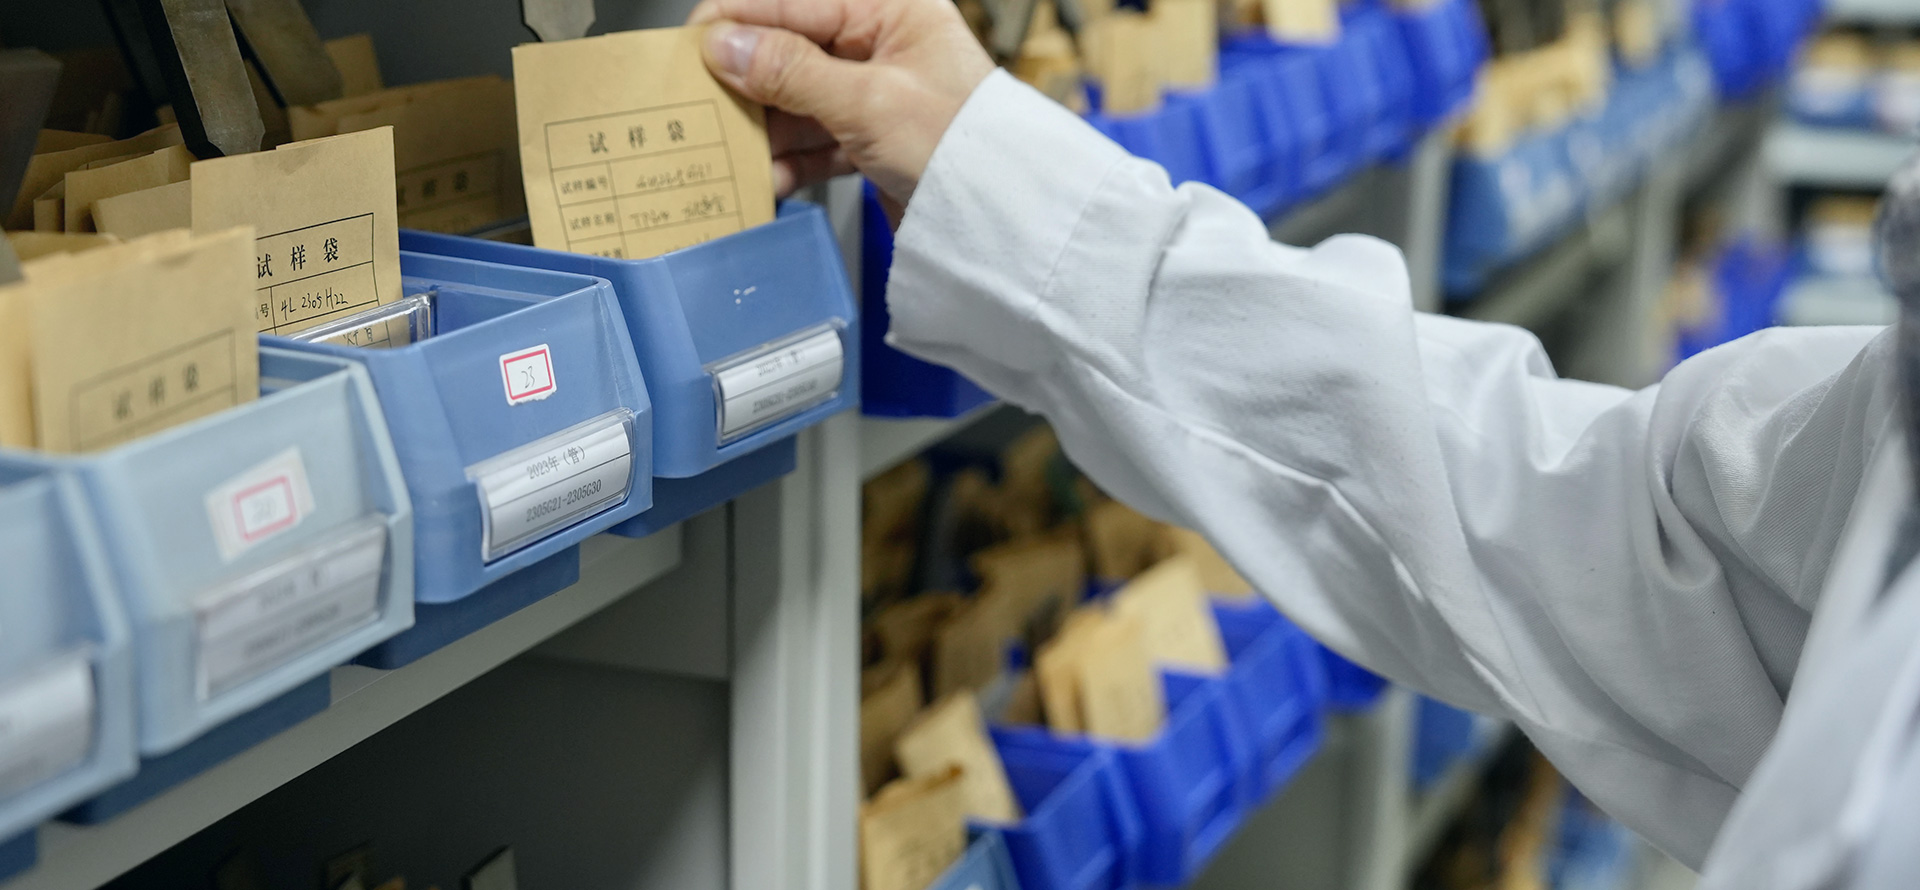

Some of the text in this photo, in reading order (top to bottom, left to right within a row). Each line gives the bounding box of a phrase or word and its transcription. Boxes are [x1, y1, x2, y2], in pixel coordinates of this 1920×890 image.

[588, 119, 686, 154] 试样袋
[256, 237, 339, 279] 试样袋
[520, 364, 536, 389] 23
[525, 478, 603, 523] 2305G21-2305G30
